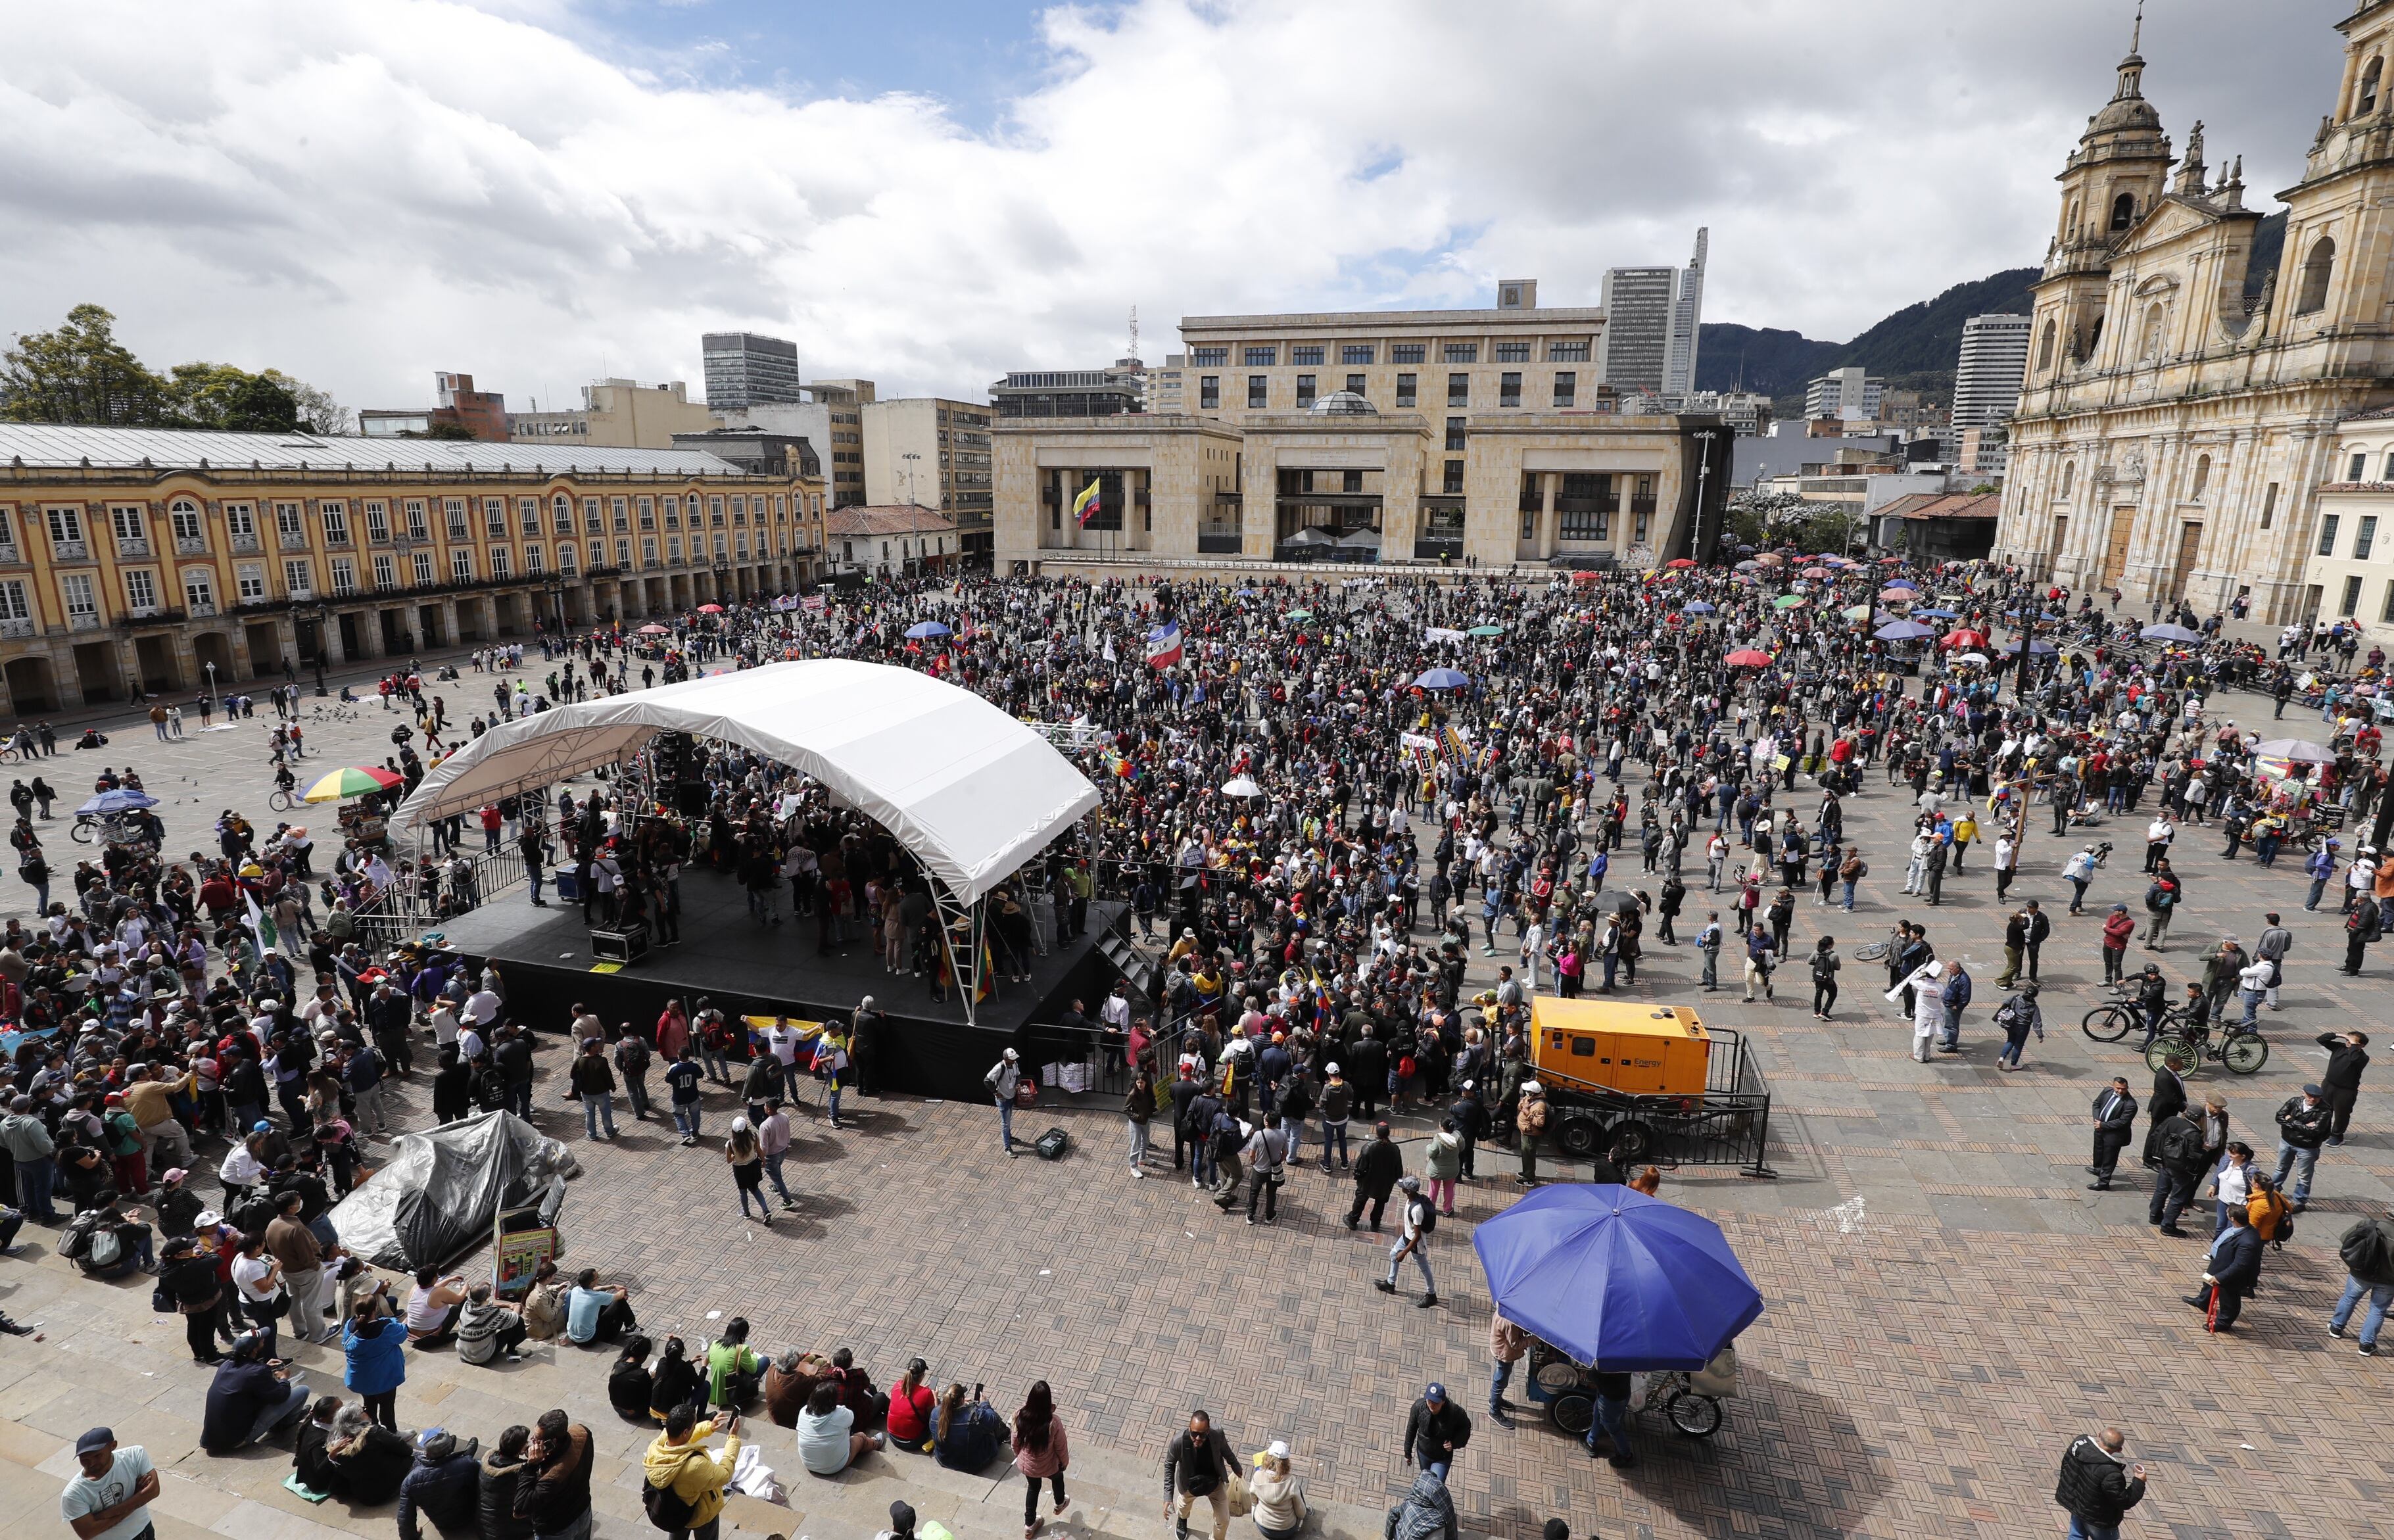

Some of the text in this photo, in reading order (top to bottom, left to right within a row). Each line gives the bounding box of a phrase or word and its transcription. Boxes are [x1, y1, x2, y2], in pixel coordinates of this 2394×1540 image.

[1439, 734, 1455, 766] CUT
[1634, 1058, 1662, 1068] Energy
[679, 1074, 692, 1088] 10
